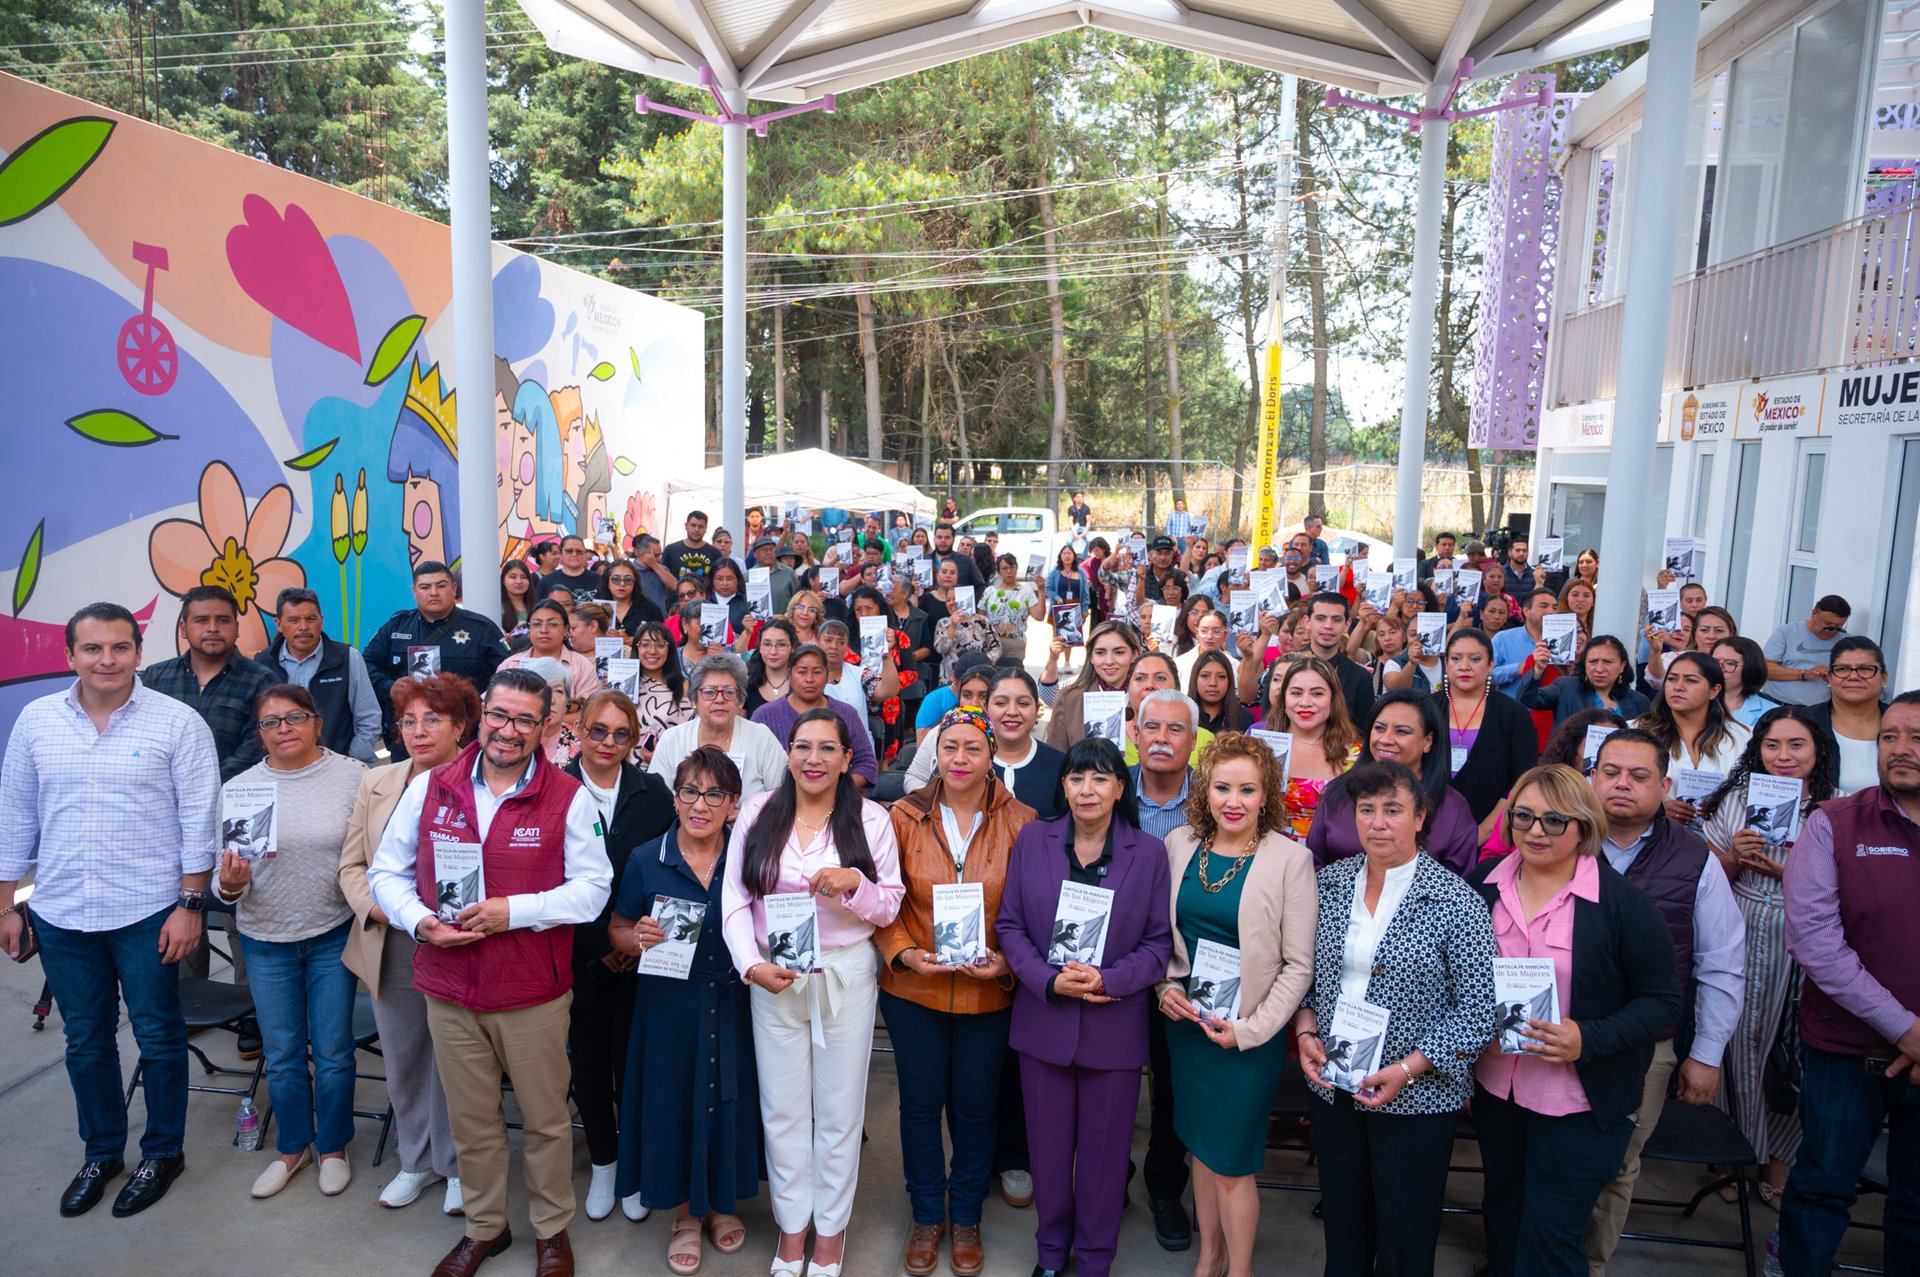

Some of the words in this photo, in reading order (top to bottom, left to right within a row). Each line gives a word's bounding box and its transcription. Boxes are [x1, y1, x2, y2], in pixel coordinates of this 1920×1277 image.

[1266, 376, 1276, 406] Doris
[1839, 371, 1920, 408] MUJE
[1265, 411, 1275, 420] El
[1700, 411, 1717, 420] ESTADO
[1838, 408, 1890, 425] SECRETARÍA
[1893, 411, 1906, 422] DE
[1581, 422, 1603, 436] México
[1699, 421, 1724, 434] MÉXICO
[429, 831, 459, 842] TRABAJO
[514, 828, 540, 836] ICATI
[1219, 955, 1240, 966] Mujere
[1520, 970, 1550, 978] Mujeres
